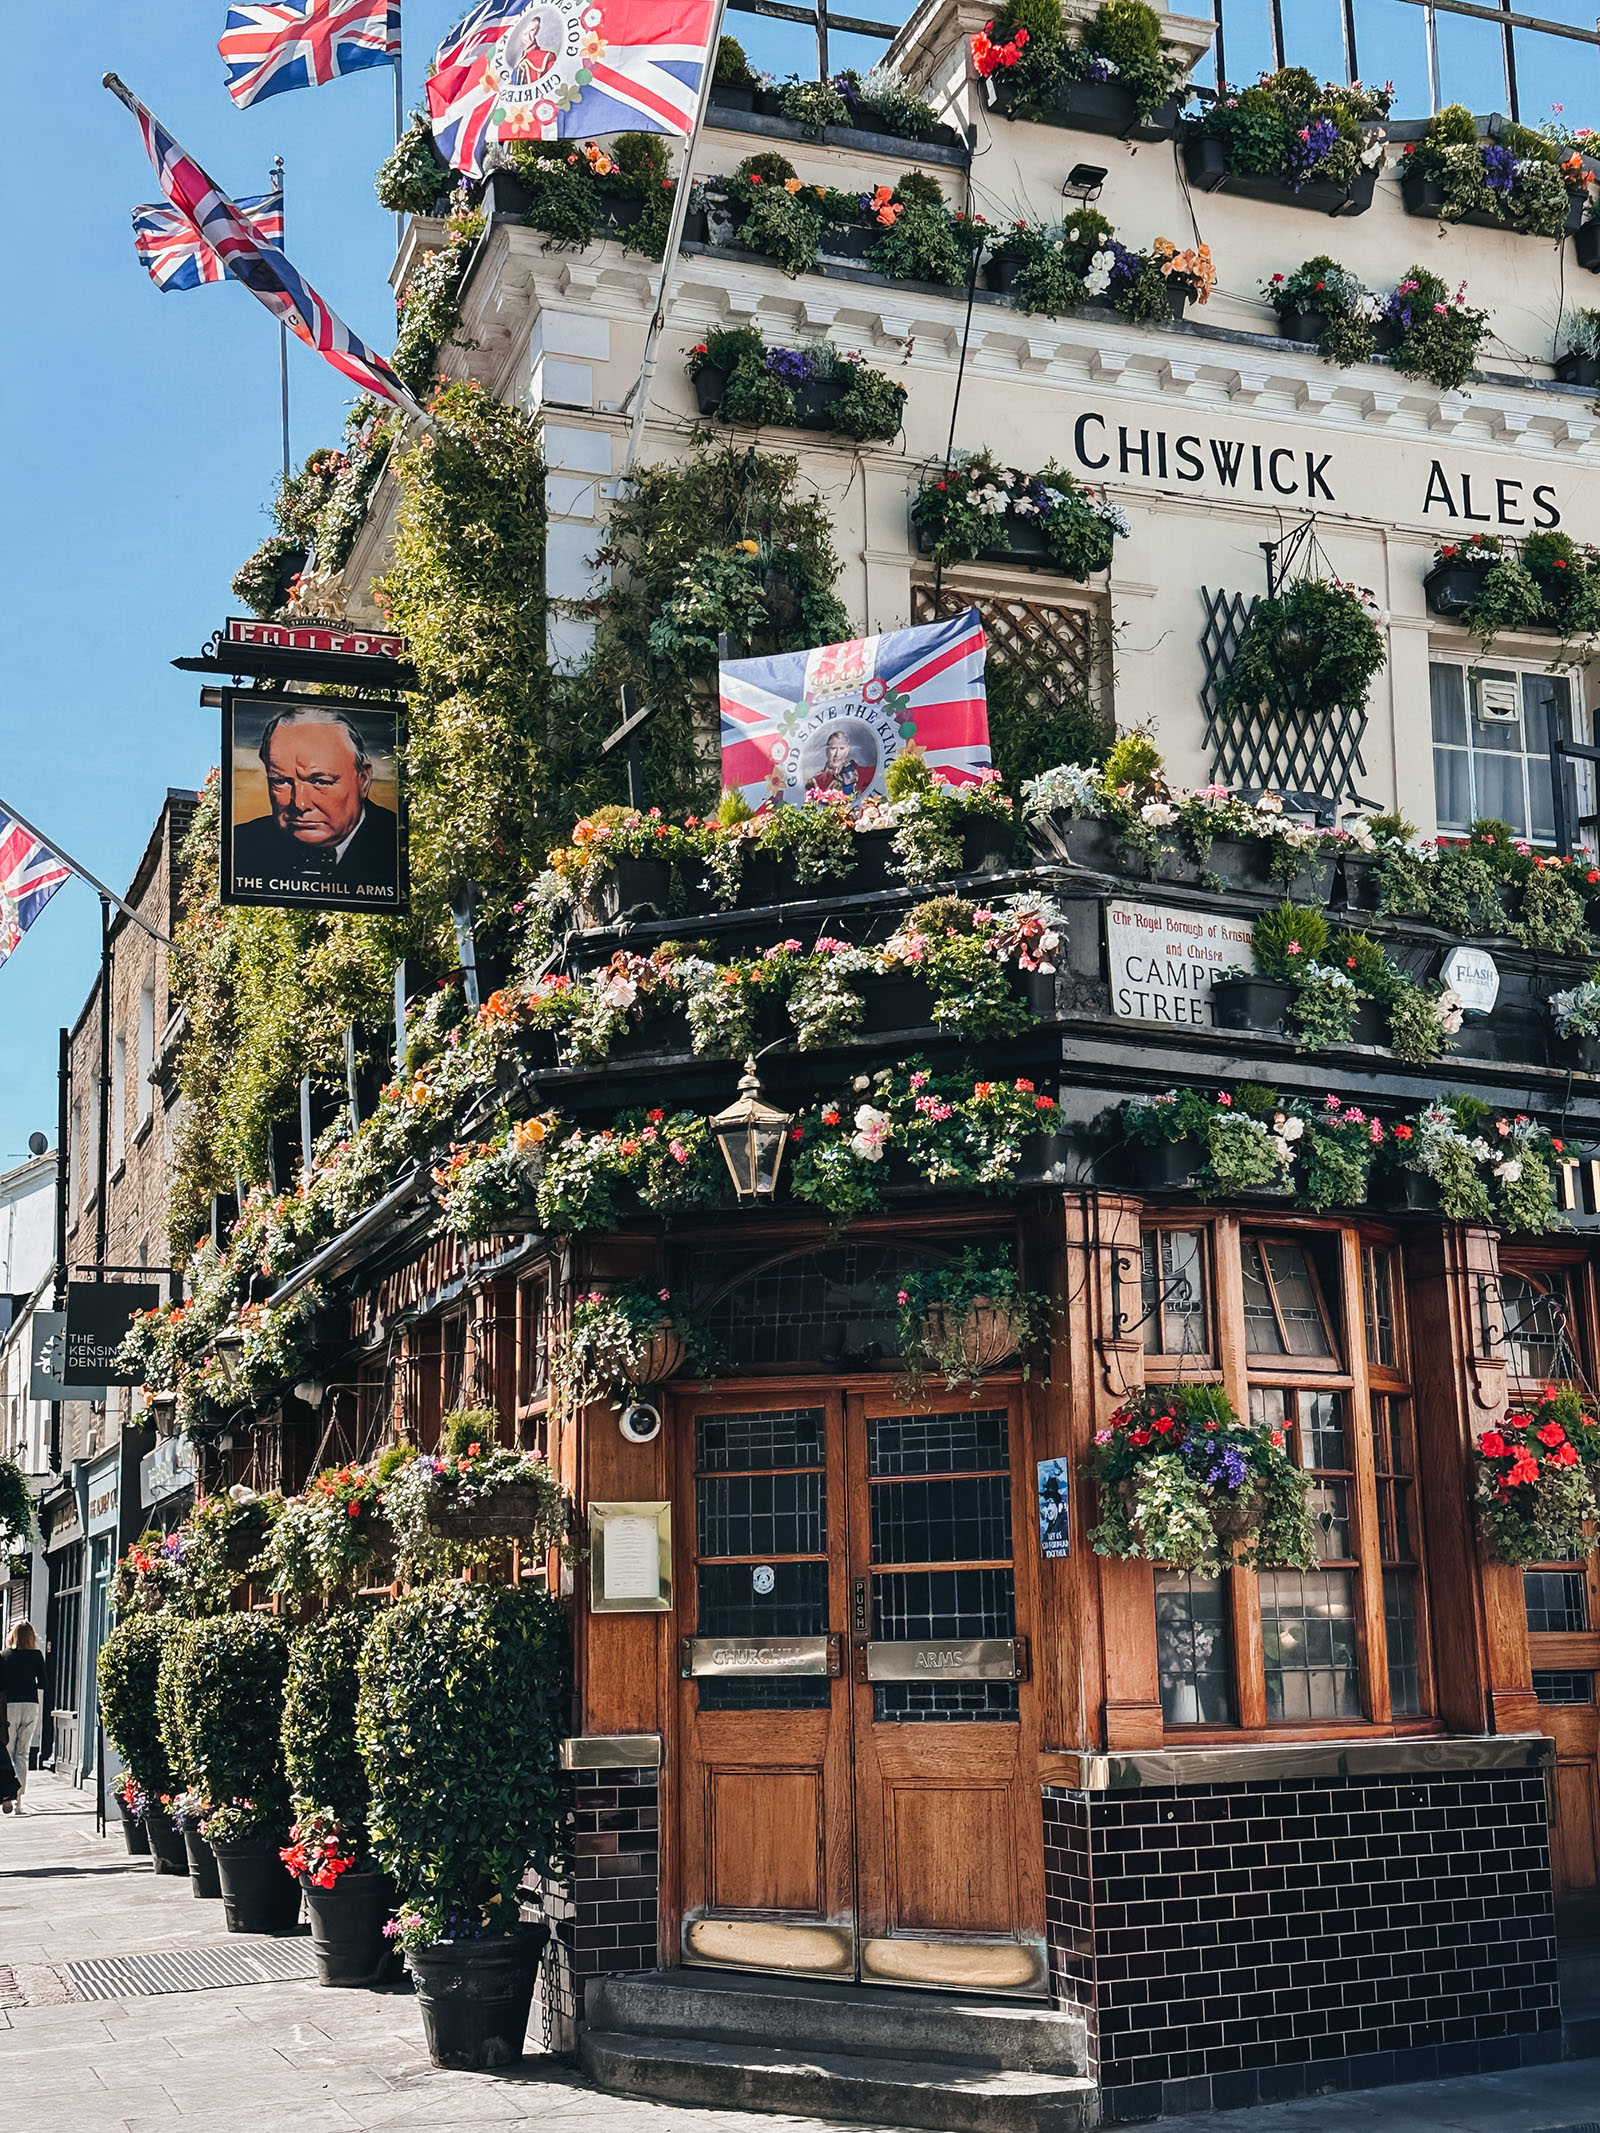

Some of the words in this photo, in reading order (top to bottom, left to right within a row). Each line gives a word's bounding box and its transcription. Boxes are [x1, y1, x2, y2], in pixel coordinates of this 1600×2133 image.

[1074, 412, 1336, 500] CHISWICK
[1422, 460, 1561, 528] ALES
[787, 747, 800, 787] GOD
[798, 706, 837, 743] SAVE
[844, 704, 878, 724] THE
[236, 877, 263, 889] THE
[269, 879, 350, 894] CHURCHILL
[355, 884, 394, 897] ARMS
[1112, 910, 1131, 926] The
[1133, 913, 1162, 933] Royal
[1166, 917, 1203, 939] Borough
[1208, 925, 1217, 938] of
[1166, 942, 1182, 957] and
[1187, 944, 1223, 961] Chelsea
[1456, 965, 1493, 982] FLASH
[1118, 988, 1218, 1027] STREET
[69, 1333, 95, 1344] THE
[69, 1345, 118, 1356] KENSIN
[69, 1357, 109, 1367] DENTI
[856, 1582, 864, 1628] PUSH
[712, 1647, 806, 1666] CHURCHILL
[914, 1651, 964, 1669] ARMS
